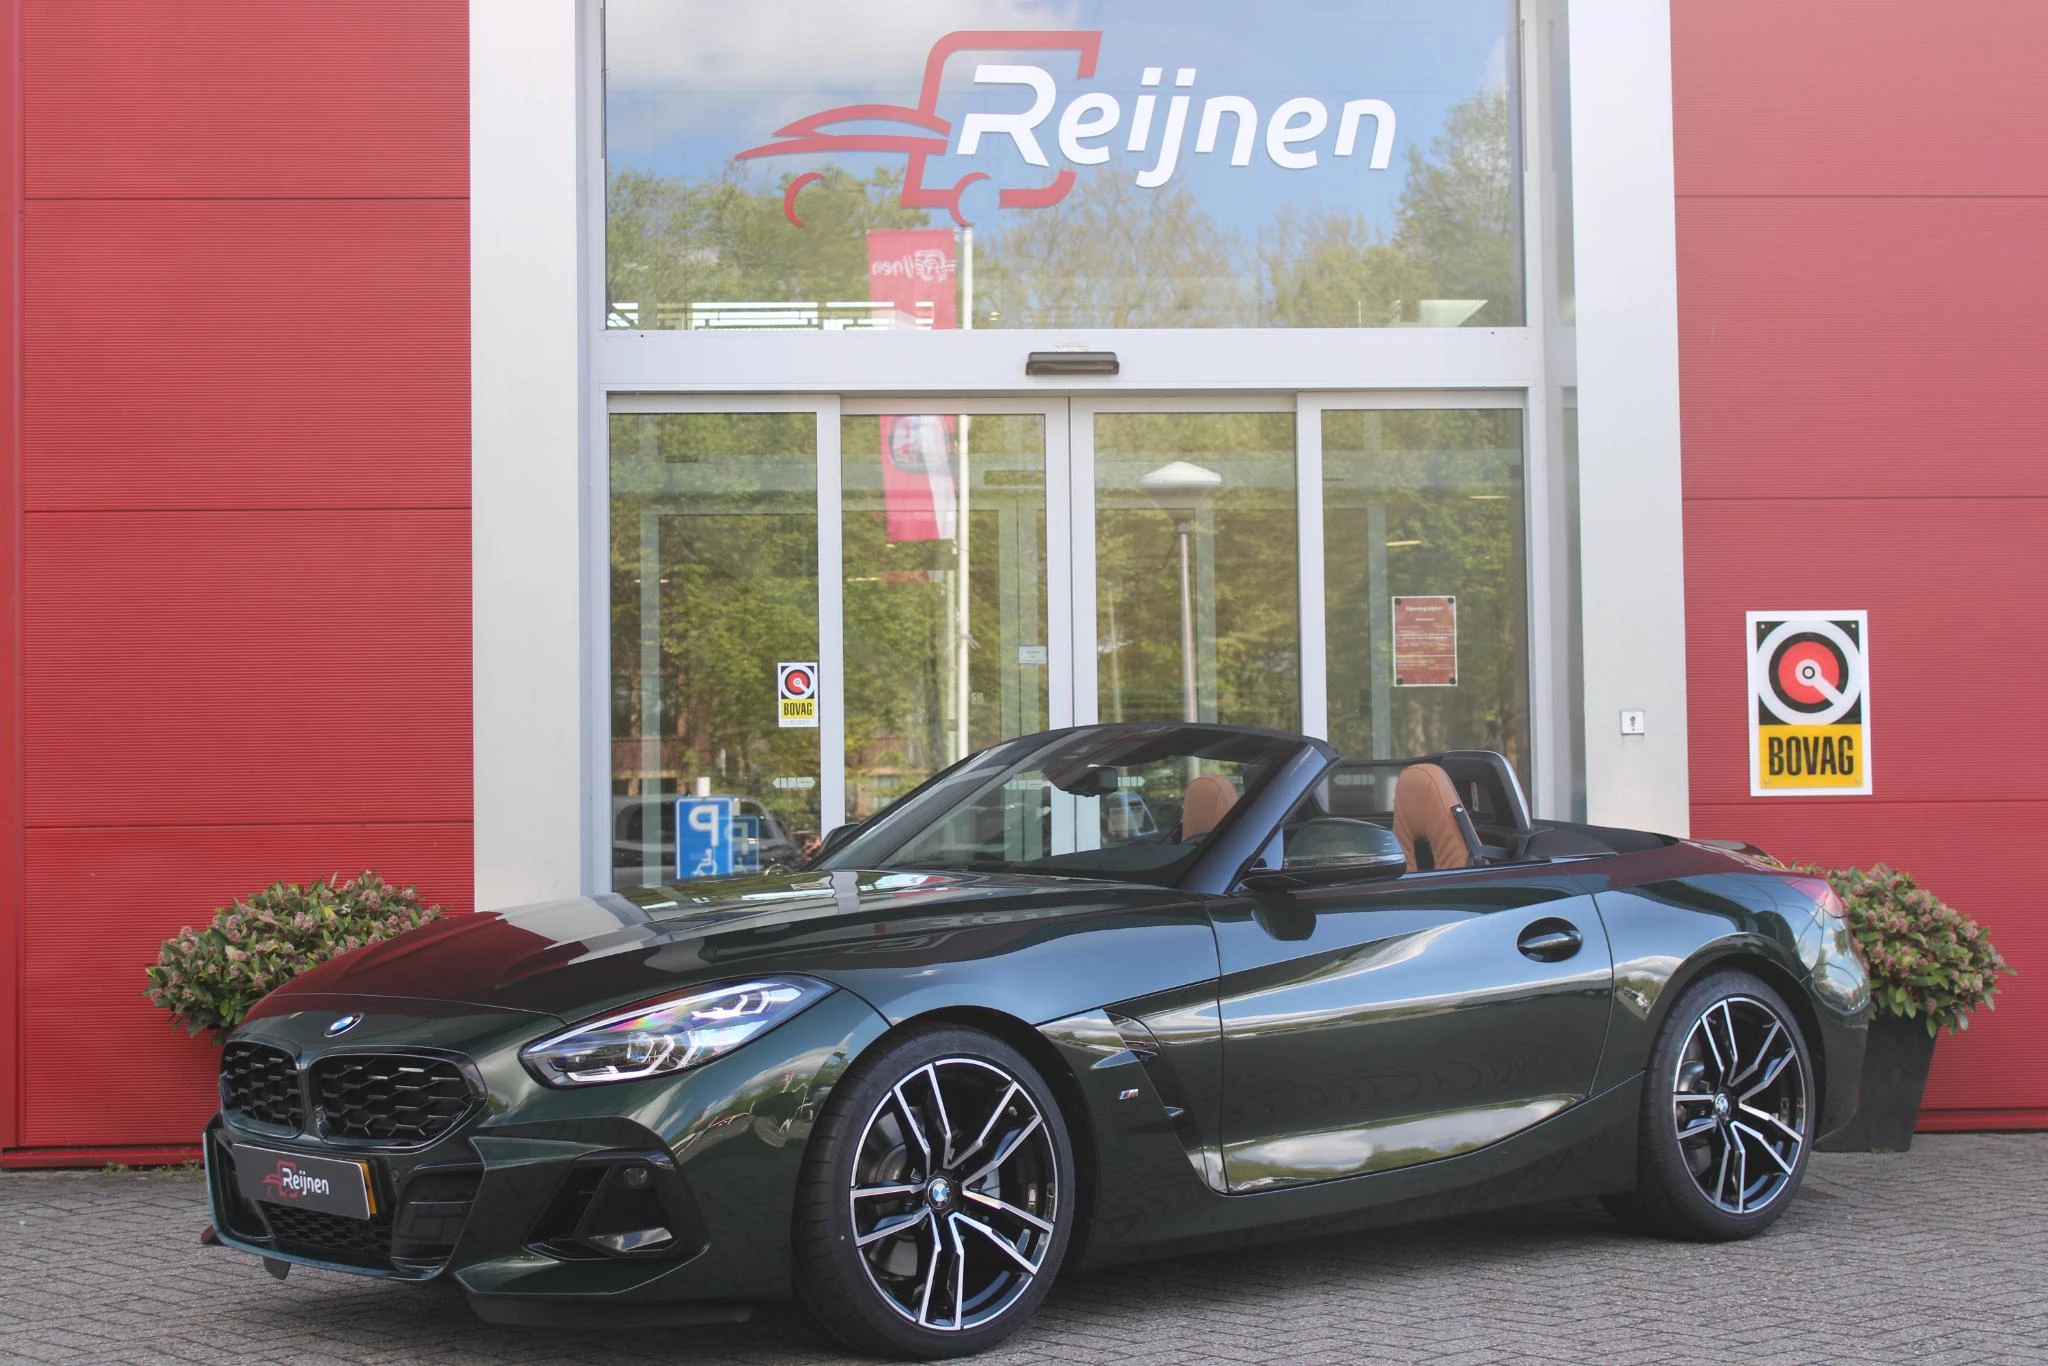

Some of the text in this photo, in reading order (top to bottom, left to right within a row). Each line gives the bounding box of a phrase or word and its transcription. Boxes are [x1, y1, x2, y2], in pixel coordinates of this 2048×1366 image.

[957, 64, 1396, 188] Reijnen
[783, 702, 812, 716] BOVAG
[1768, 735, 1854, 776] BOVAG
[282, 1167, 329, 1196] Reijnen
